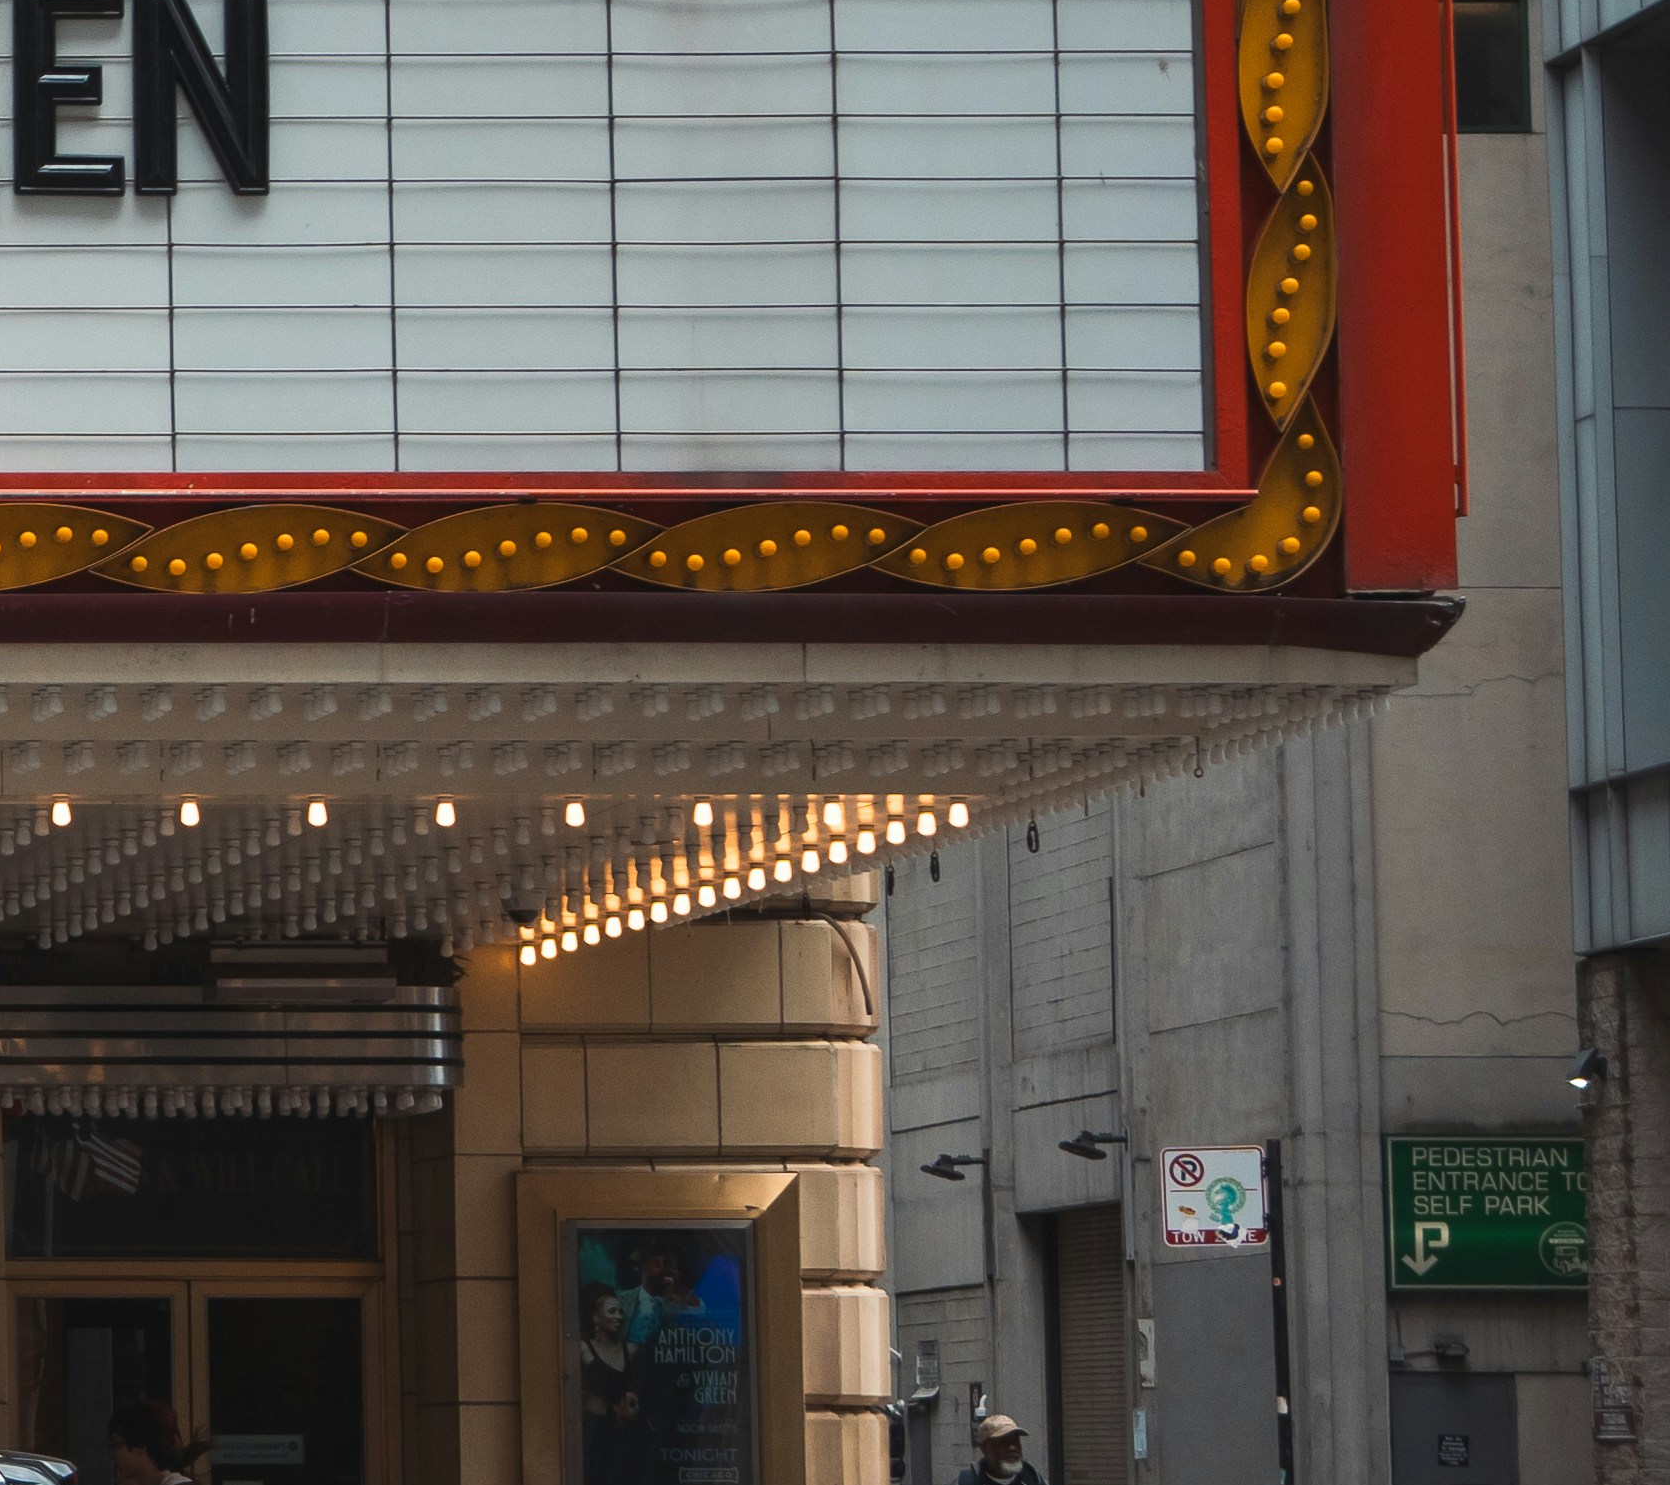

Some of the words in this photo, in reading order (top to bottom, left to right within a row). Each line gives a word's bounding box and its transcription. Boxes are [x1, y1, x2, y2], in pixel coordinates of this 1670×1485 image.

[1412, 1147, 1568, 1167] PEDESTRIAN
[1413, 1171, 1549, 1191] ENTRANCE
[1414, 1195, 1473, 1215] SELF
[1485, 1195, 1551, 1216] PARK
[1172, 1231, 1205, 1244] TOW
[657, 1327, 735, 1346] ANTHONY
[654, 1345, 735, 1364] HAMILTON
[692, 1370, 738, 1386] VIVIAN
[694, 1387, 737, 1404] GREEN
[659, 1448, 738, 1461] TONIGHT
